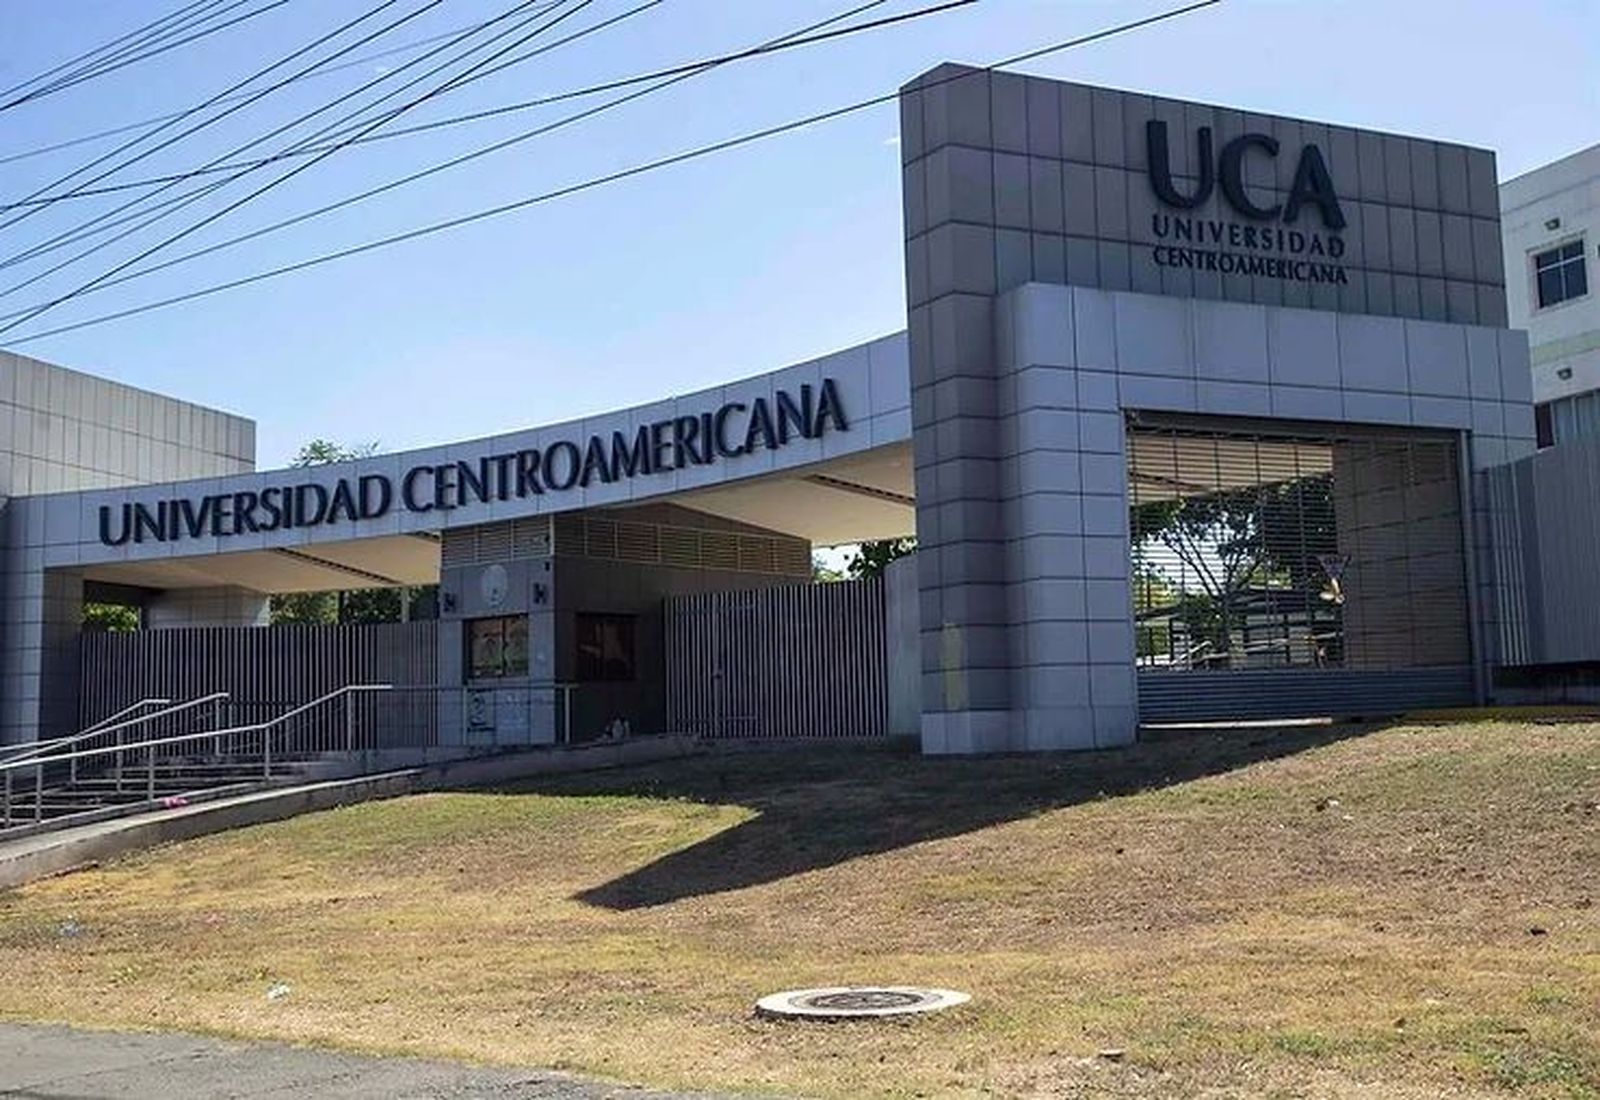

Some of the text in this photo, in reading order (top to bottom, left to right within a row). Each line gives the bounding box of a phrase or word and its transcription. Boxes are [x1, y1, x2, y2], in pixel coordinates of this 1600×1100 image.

[1147, 121, 1346, 229] UCA
[1153, 214, 1345, 258] UNIVERSIDAD
[1153, 247, 1348, 284] CENTROAMERICANA
[99, 378, 848, 547] UNIVERSIDAD CENTROAMERICANA
